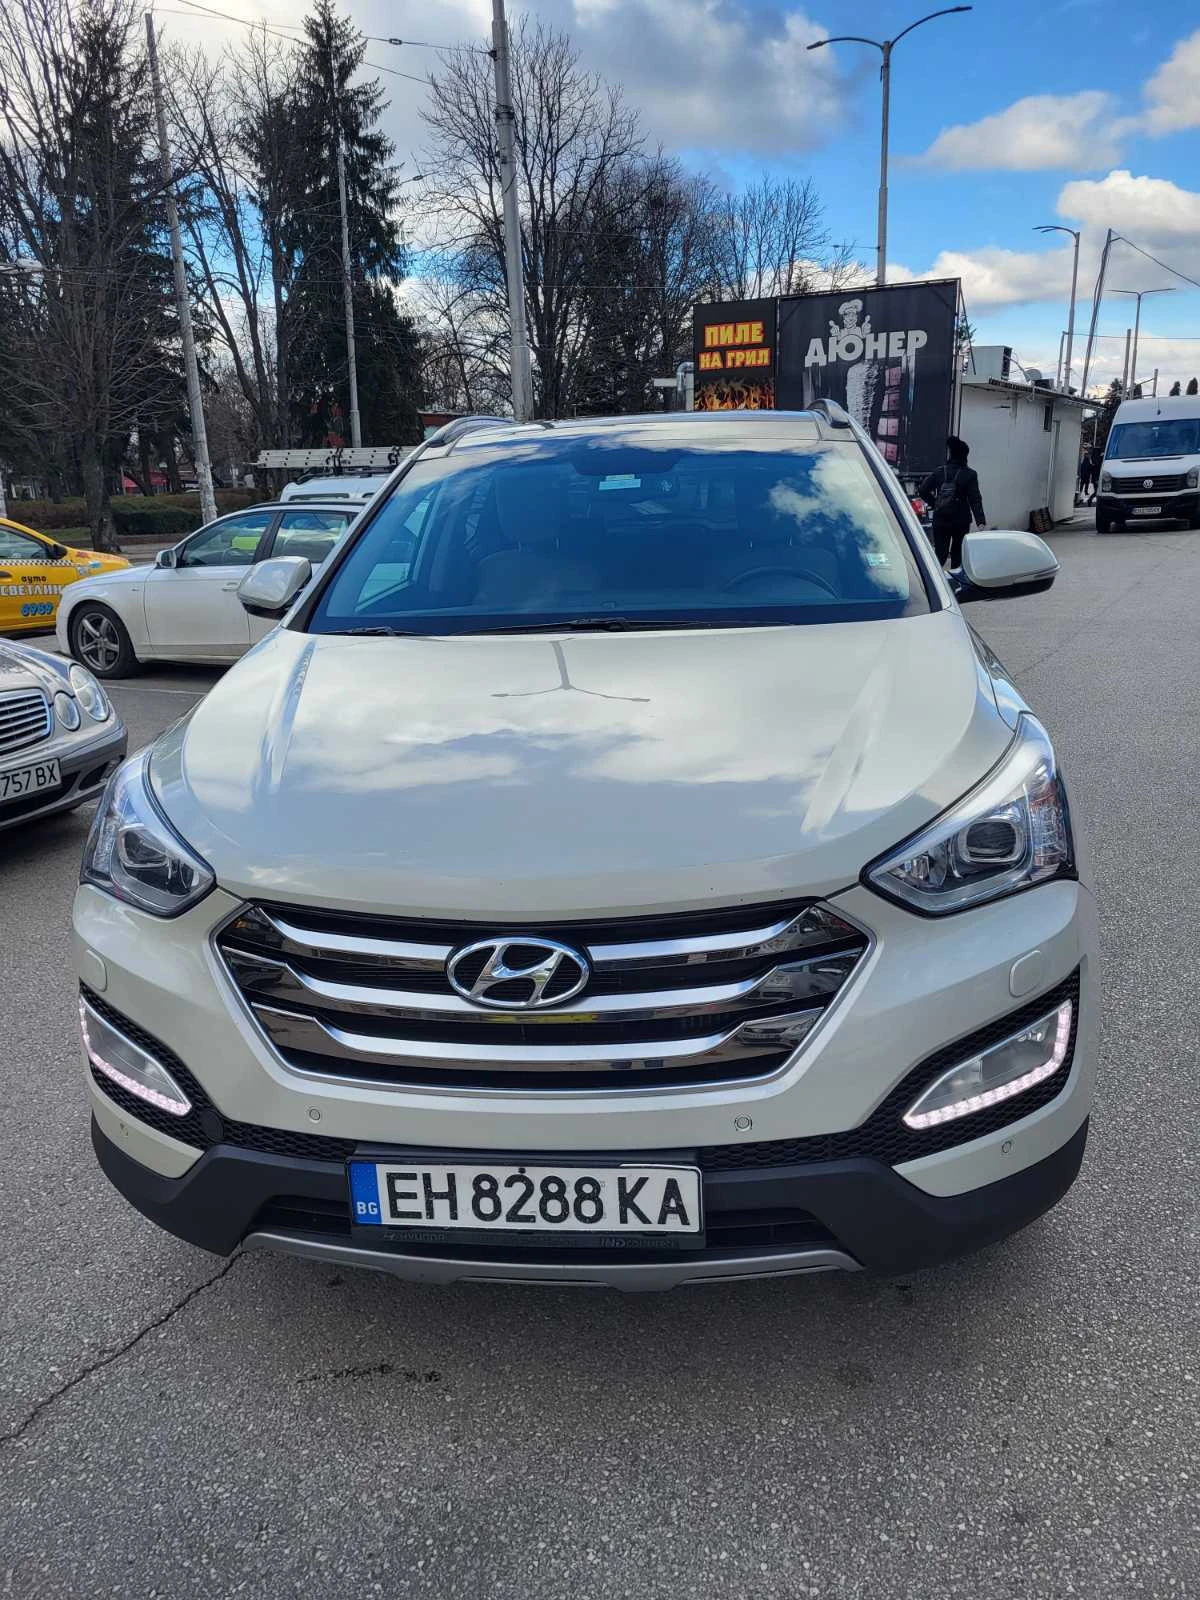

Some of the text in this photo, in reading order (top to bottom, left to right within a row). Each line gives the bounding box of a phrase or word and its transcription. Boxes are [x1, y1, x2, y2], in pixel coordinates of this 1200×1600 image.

[705, 321, 764, 347] ПИЛЕ
[699, 348, 770, 370] НА ГРИЛ
[805, 330, 927, 367] ДЮНЕР
[36, 763, 57, 787] BX
[357, 1202, 378, 1215] BG
[386, 1172, 690, 1226] EH 8288 KA
